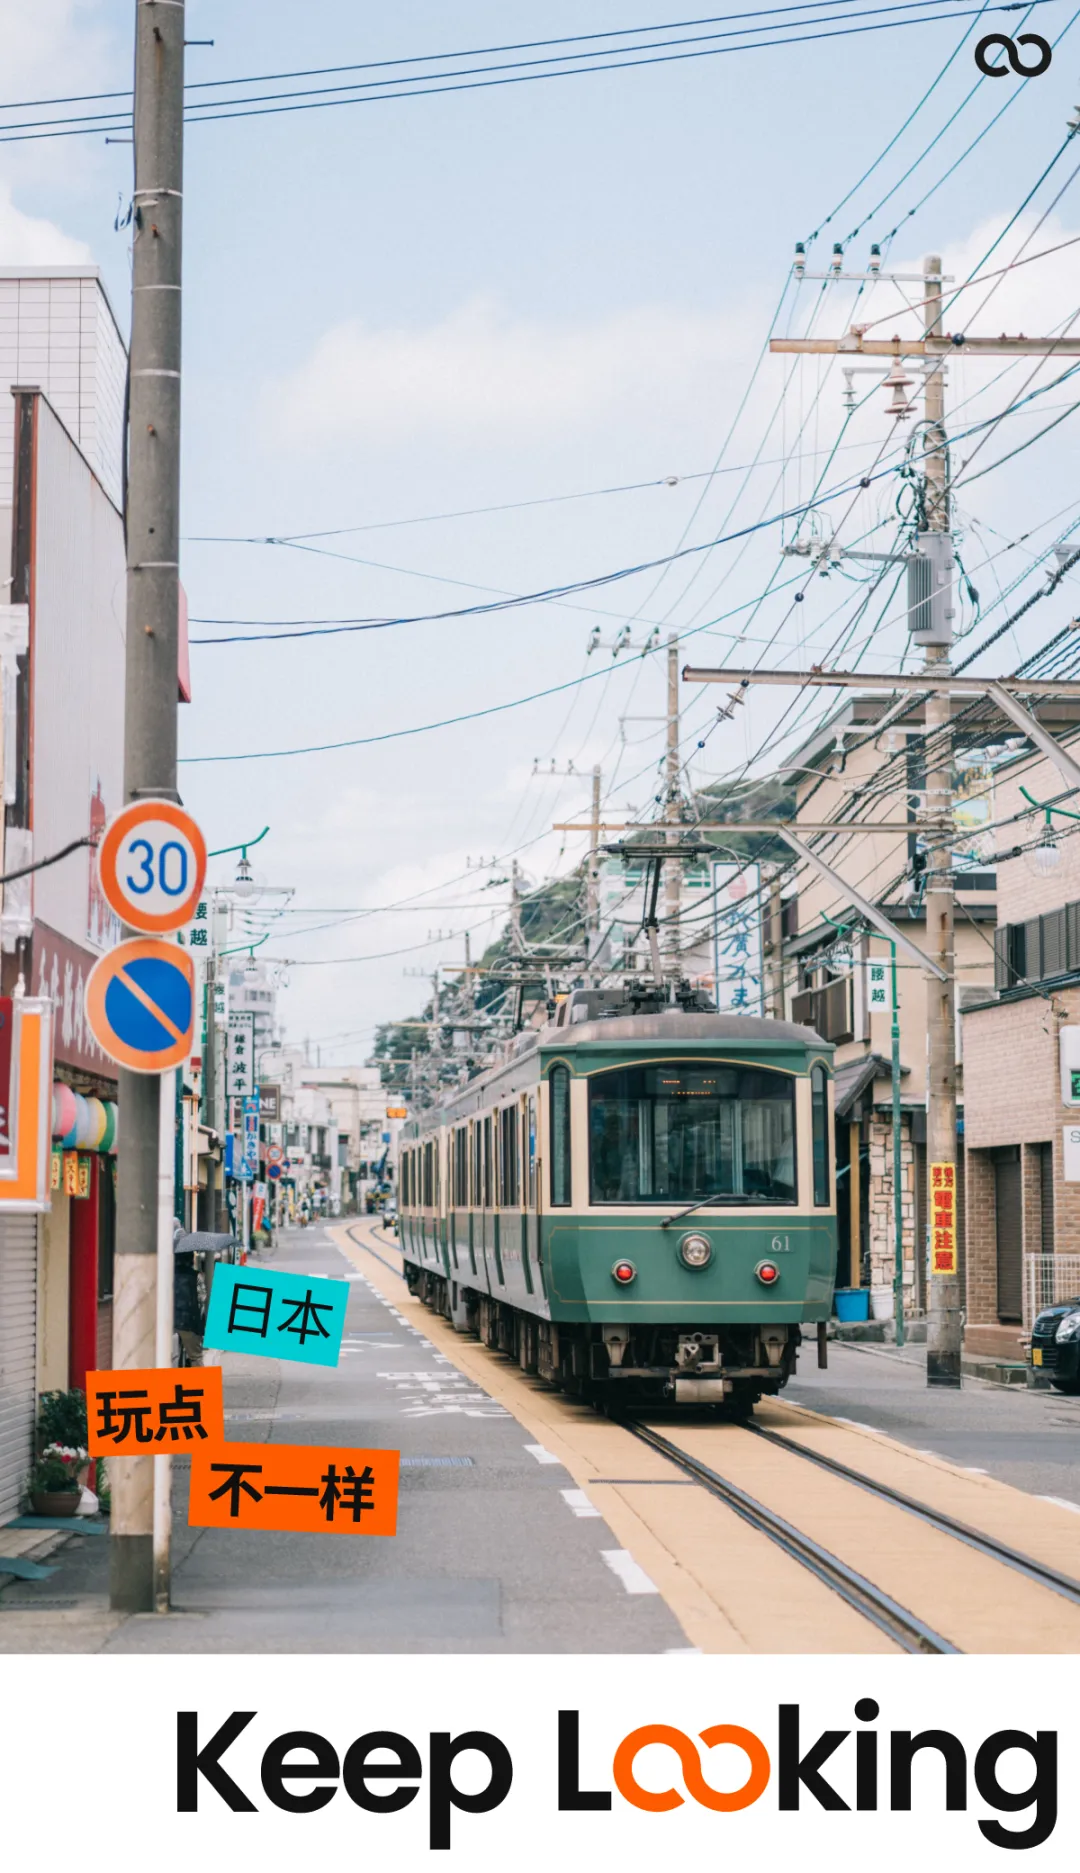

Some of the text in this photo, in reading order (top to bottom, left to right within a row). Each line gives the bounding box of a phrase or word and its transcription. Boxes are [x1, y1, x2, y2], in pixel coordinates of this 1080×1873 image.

[126, 839, 187, 896] 30
[870, 967, 885, 1002] 腰越
[772, 1236, 789, 1251] 61
[934, 1190, 953, 1270] 電車注意
